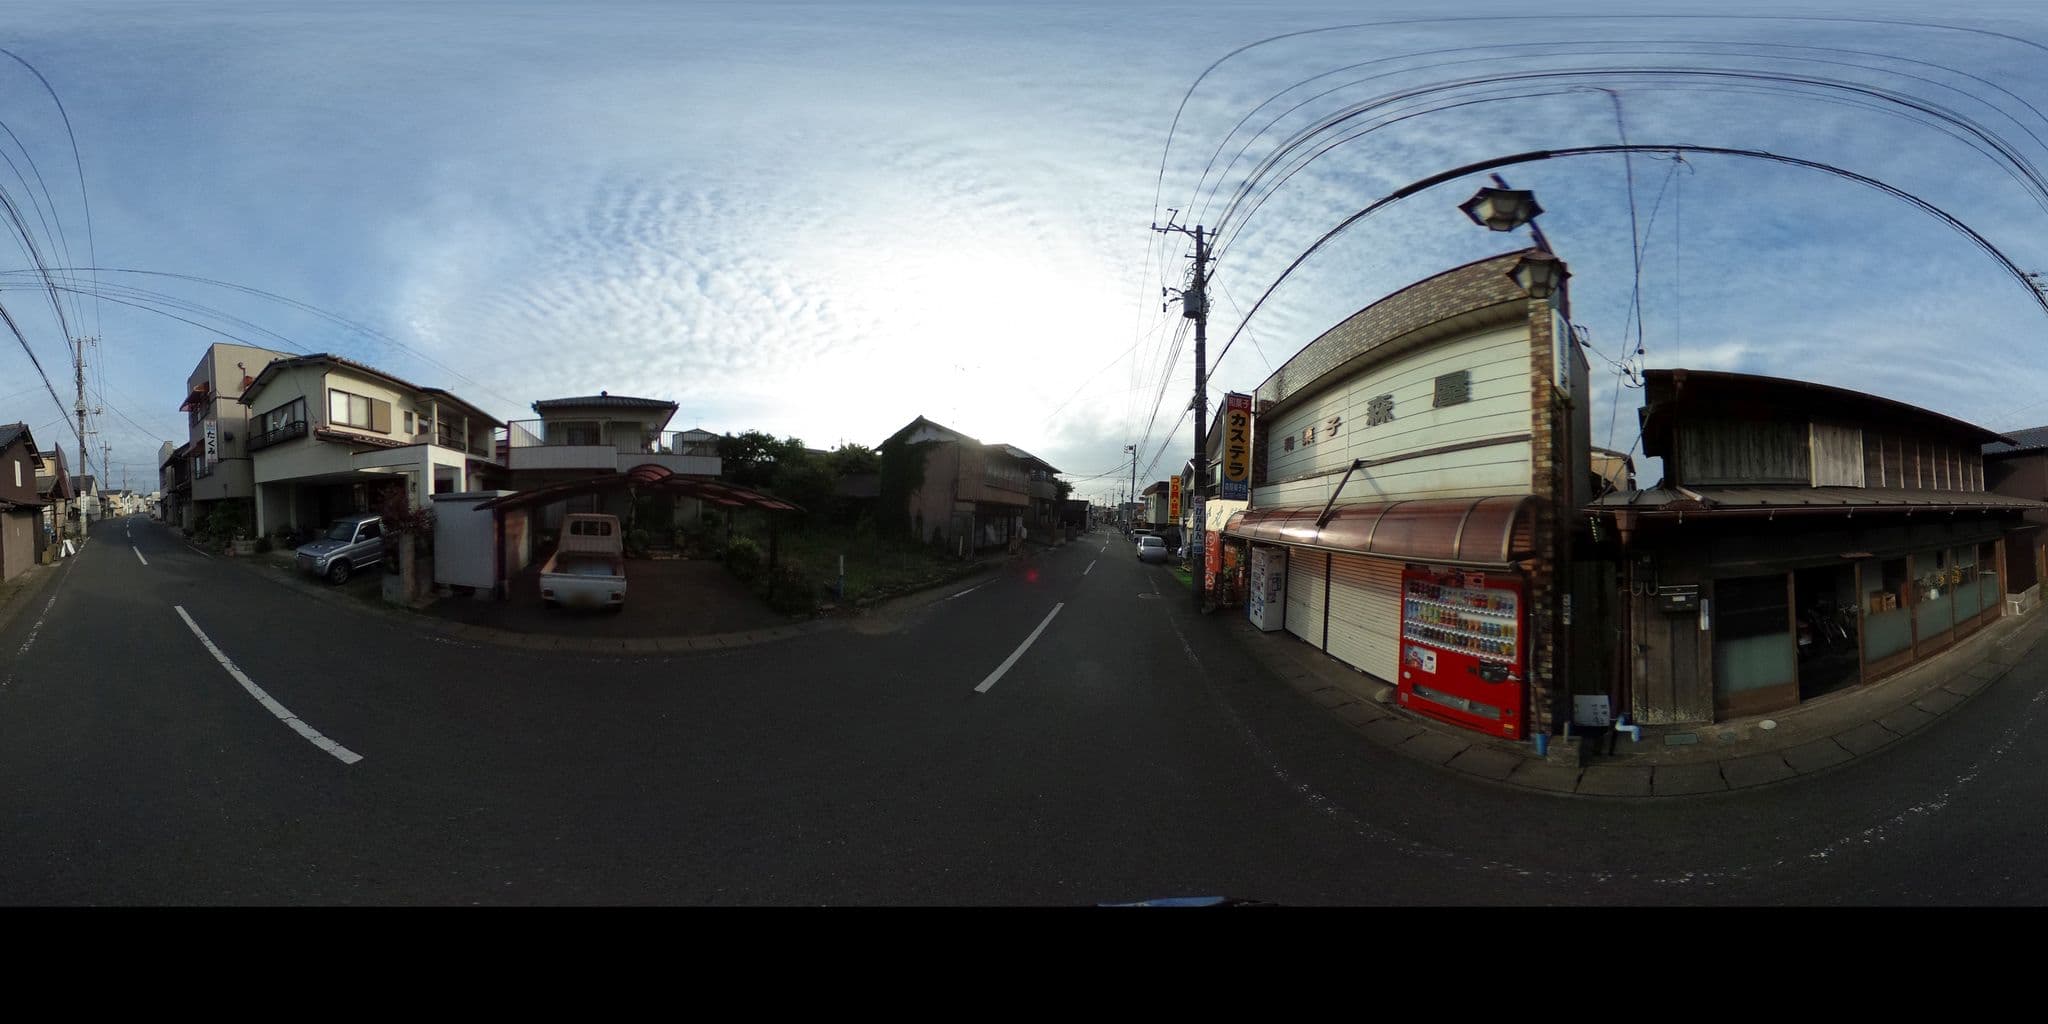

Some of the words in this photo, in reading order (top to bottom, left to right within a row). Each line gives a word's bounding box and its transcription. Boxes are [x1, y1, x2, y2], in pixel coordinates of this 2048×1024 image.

[206, 430, 216, 455] たくみ
[1229, 413, 1247, 476] カステラ
